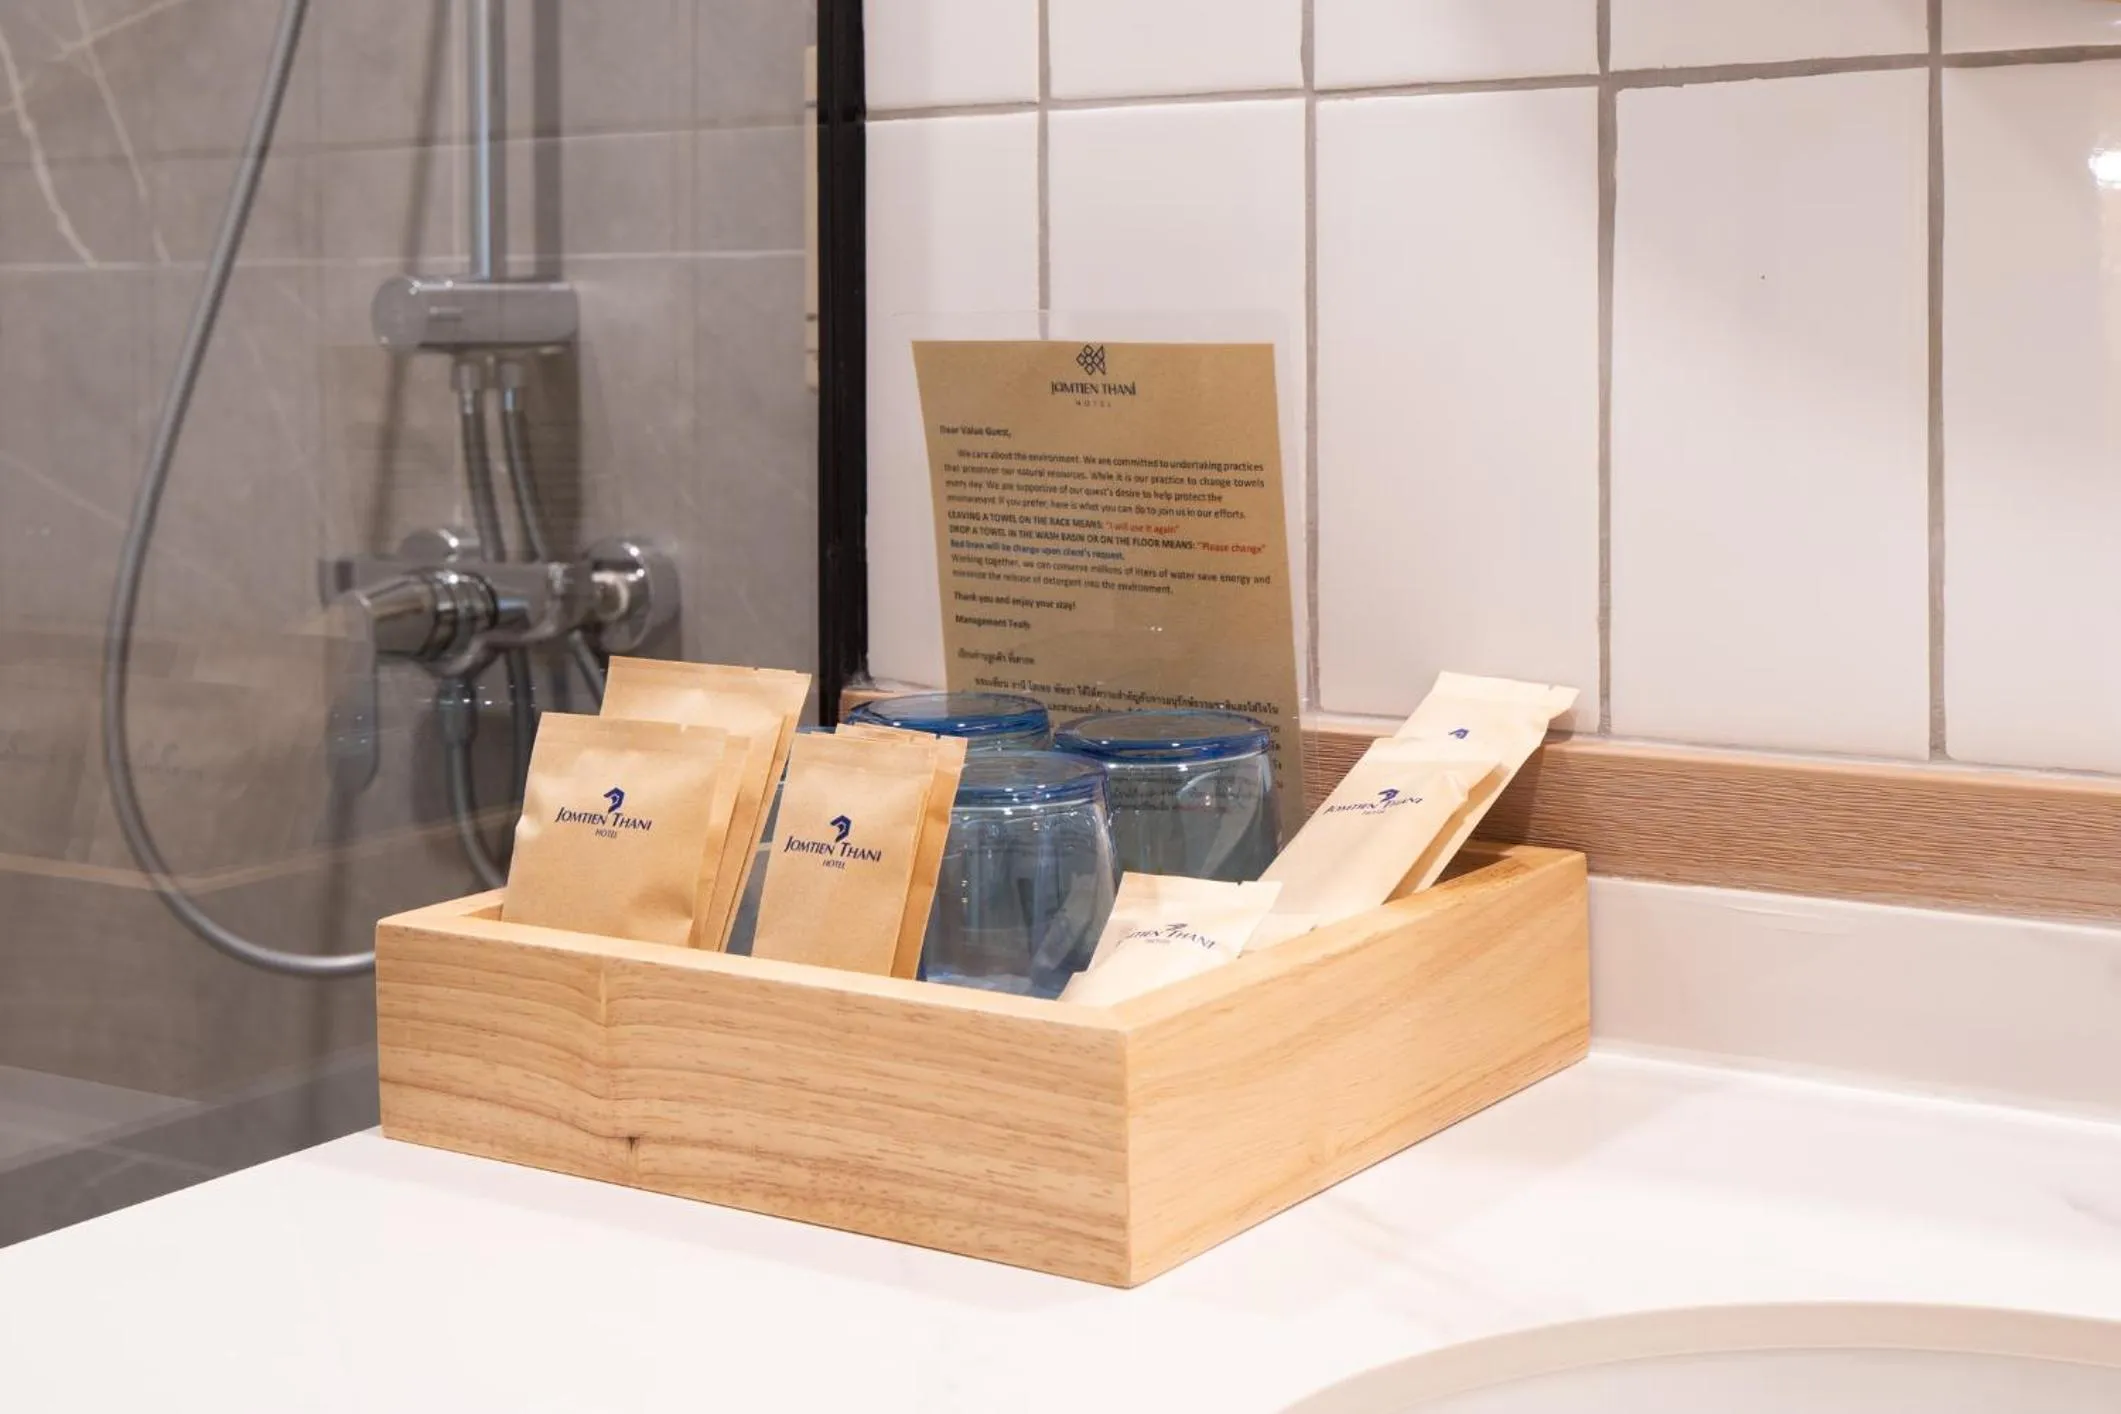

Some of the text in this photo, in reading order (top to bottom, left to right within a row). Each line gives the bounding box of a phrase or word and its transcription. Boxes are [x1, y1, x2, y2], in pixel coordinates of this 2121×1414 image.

[1052, 381, 1136, 395] JOMTIEN THANI
[940, 425, 1011, 438] Dear Value Guest,
[958, 449, 970, 457] We
[971, 451, 989, 459] care
[991, 450, 1012, 460] about
[1014, 452, 1027, 460] the
[1083, 456, 1096, 464] We
[1098, 457, 1111, 465] are
[1113, 457, 1160, 468] committed
[1160, 459, 1169, 468] to
[1170, 460, 1223, 472] undertaking
[1224, 462, 1264, 472] practices
[944, 463, 959, 472] that
[1017, 467, 1045, 477] natural
[1090, 471, 1113, 480] While
[1116, 472, 1123, 481] it
[1125, 473, 1132, 481] is
[1133, 475, 1149, 483] our
[1151, 474, 1184, 485] practice
[1187, 476, 1197, 485] to
[1199, 477, 1233, 488] change
[1234, 479, 1264, 488] towels
[946, 480, 966, 490] every
[986, 480, 1000, 489] We
[1016, 484, 1057, 494] supportive
[1059, 484, 1067, 494] of
[1069, 486, 1082, 494] our
[1115, 488, 1140, 497] desire
[1142, 490, 1152, 499] to
[1153, 490, 1173, 501] help
[1174, 491, 1206, 502] protect
[1207, 492, 1223, 502] the
[1006, 498, 1019, 507] you
[1079, 502, 1099, 511] what
[1101, 504, 1116, 514] you
[1117, 504, 1132, 513] can
[1135, 503, 1145, 514] do
[1146, 506, 1156, 515] to
[1157, 506, 1175, 518] join
[1176, 509, 1185, 517] us
[1186, 507, 1196, 517] in
[1197, 509, 1212, 518] our
[1214, 509, 1246, 520] efforts.
[948, 510, 981, 521] LEAVING
[982, 512, 989, 521] A
[989, 513, 1017, 524] TOWEL
[1019, 515, 1032, 524] ON
[1033, 515, 1049, 526] THE
[1050, 517, 1070, 526] RACK
[1073, 518, 1103, 529] MEANS:
[1114, 521, 1128, 531] will
[1130, 523, 1143, 532] use
[1152, 524, 1180, 535] again"
[949, 524, 1266, 555] DROP A TOWEL IN THE WASH BASIN OR ON THE FLOOR MEANS: "Please change"
[986, 541, 1000, 550] will
[1001, 542, 1012, 551] be
[1012, 544, 1040, 555] change
[1042, 547, 1061, 557] upon
[1063, 547, 1091, 558] client's
[951, 553, 983, 566] Working
[1036, 561, 1051, 569] can
[1052, 561, 1088, 572] conserve
[1090, 563, 1122, 575] millions
[1124, 566, 1133, 575] of
[1158, 568, 1168, 578] of
[1170, 570, 1194, 580] water
[1198, 573, 1217, 582] save
[1219, 573, 1250, 586] energy
[1254, 574, 1271, 585] and
[988, 571, 1001, 580] the
[1003, 573, 1031, 583] release
[1033, 575, 1041, 583] of
[1043, 576, 1081, 588] detergent
[1084, 578, 1100, 588] into
[1101, 579, 1116, 590] the
[1117, 582, 1174, 595] environment.
[954, 591, 1076, 611] Thank you and enjoy your stay!
[955, 614, 1006, 627] Management
[555, 807, 652, 831] JOMTIEN THANI
[595, 828, 618, 838] HOTEL
[784, 836, 882, 862] JOMTIEN THANI
[823, 859, 846, 869] HOTEL
[1167, 929, 1215, 949] THANI
